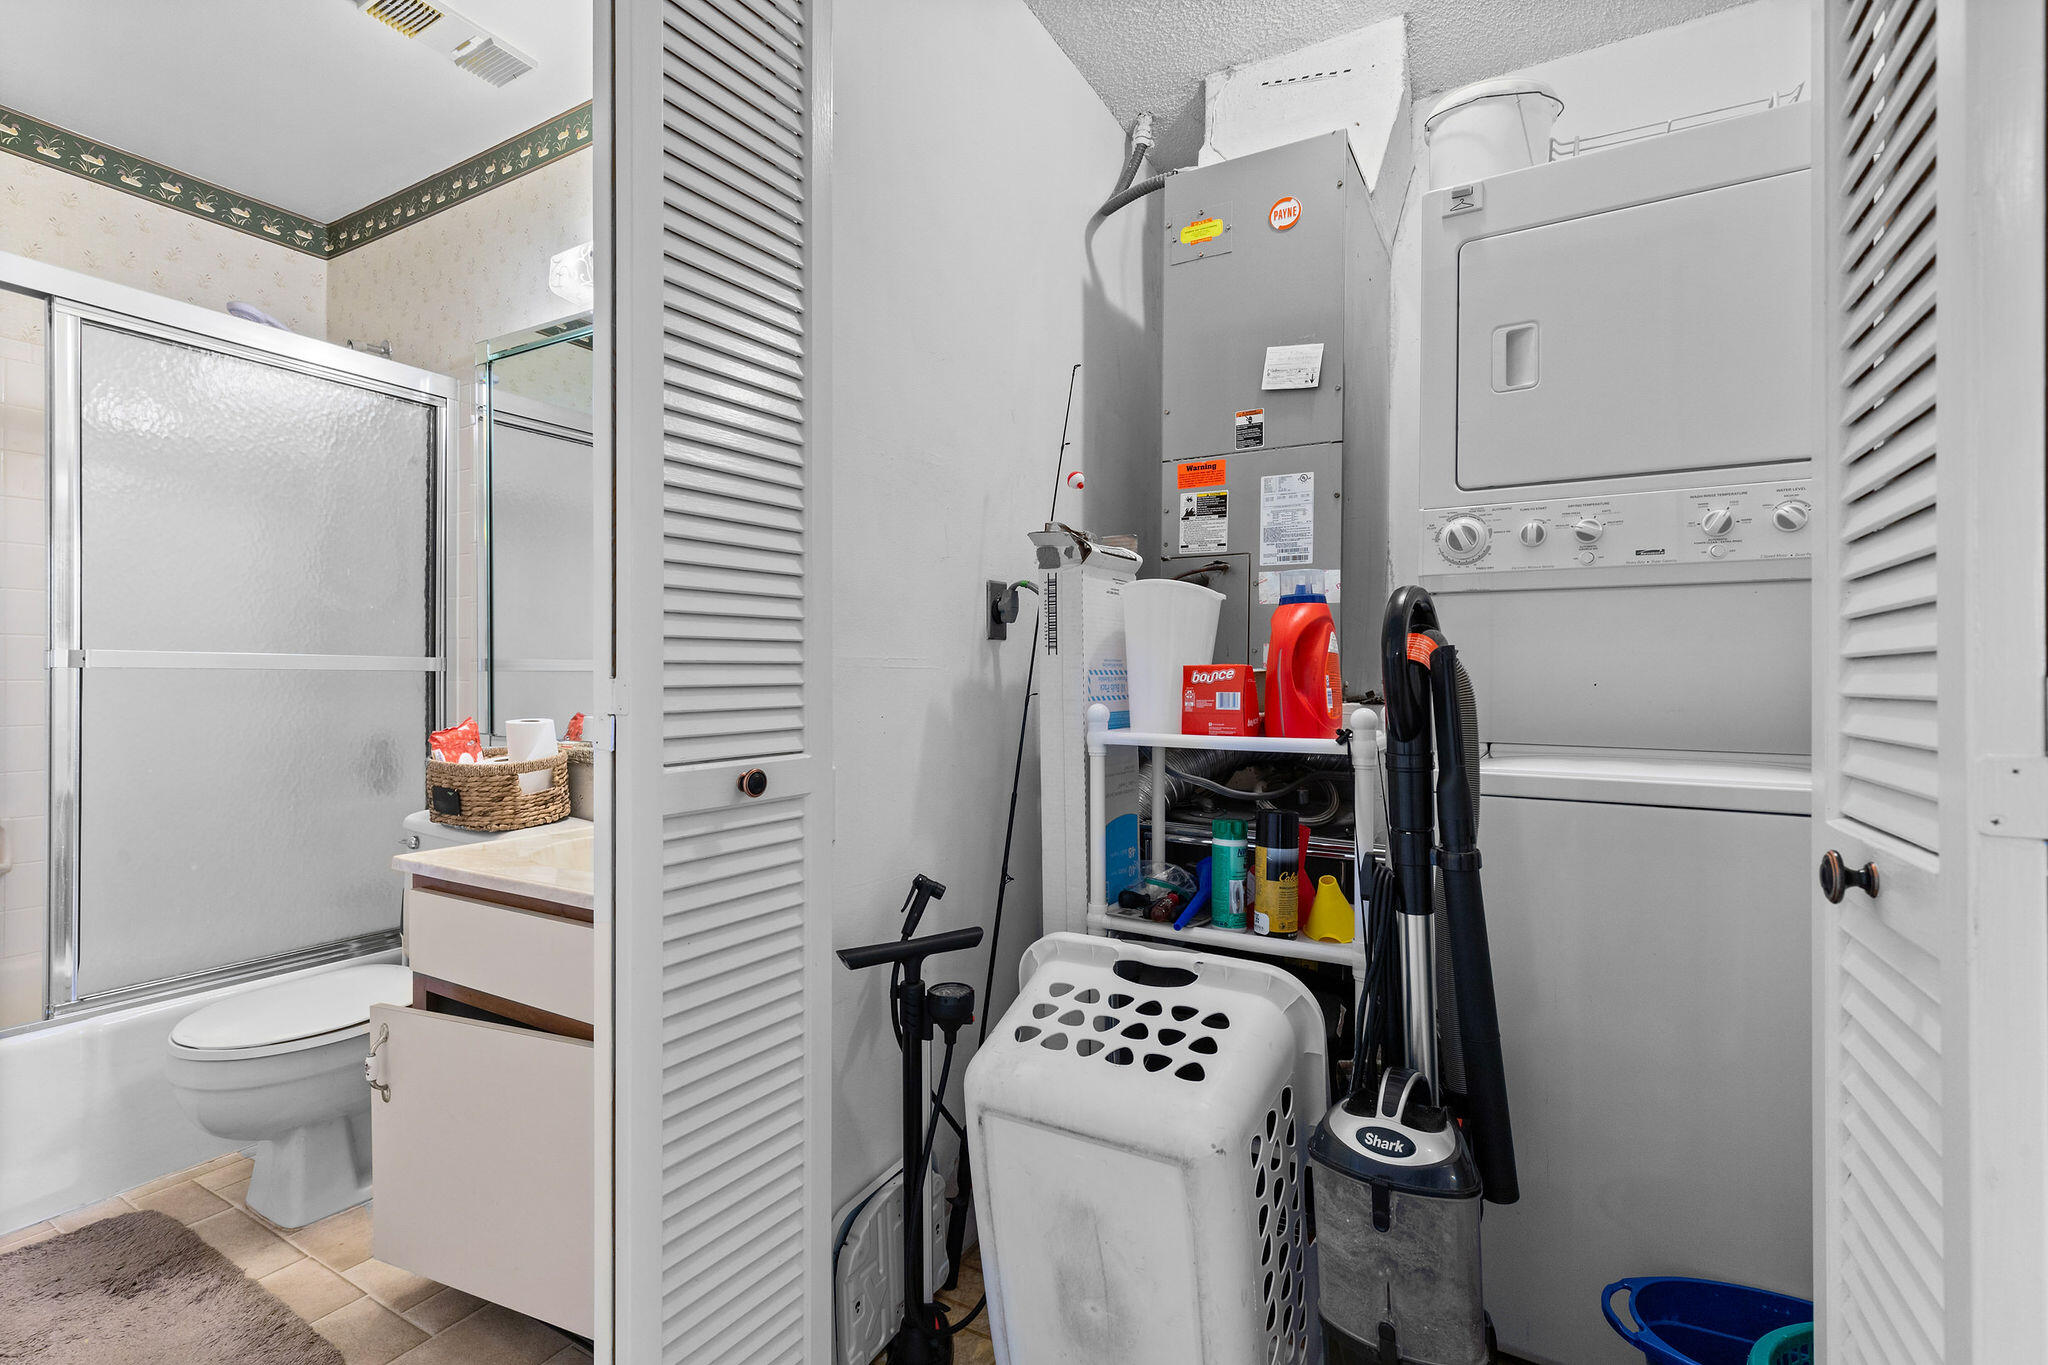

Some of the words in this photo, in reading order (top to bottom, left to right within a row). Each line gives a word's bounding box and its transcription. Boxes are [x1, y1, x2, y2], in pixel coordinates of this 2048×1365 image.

[1273, 205, 1297, 221] PAYNE
[1186, 463, 1217, 472] Warning
[1191, 669, 1235, 684] bounce
[1364, 1132, 1405, 1153] Shark
